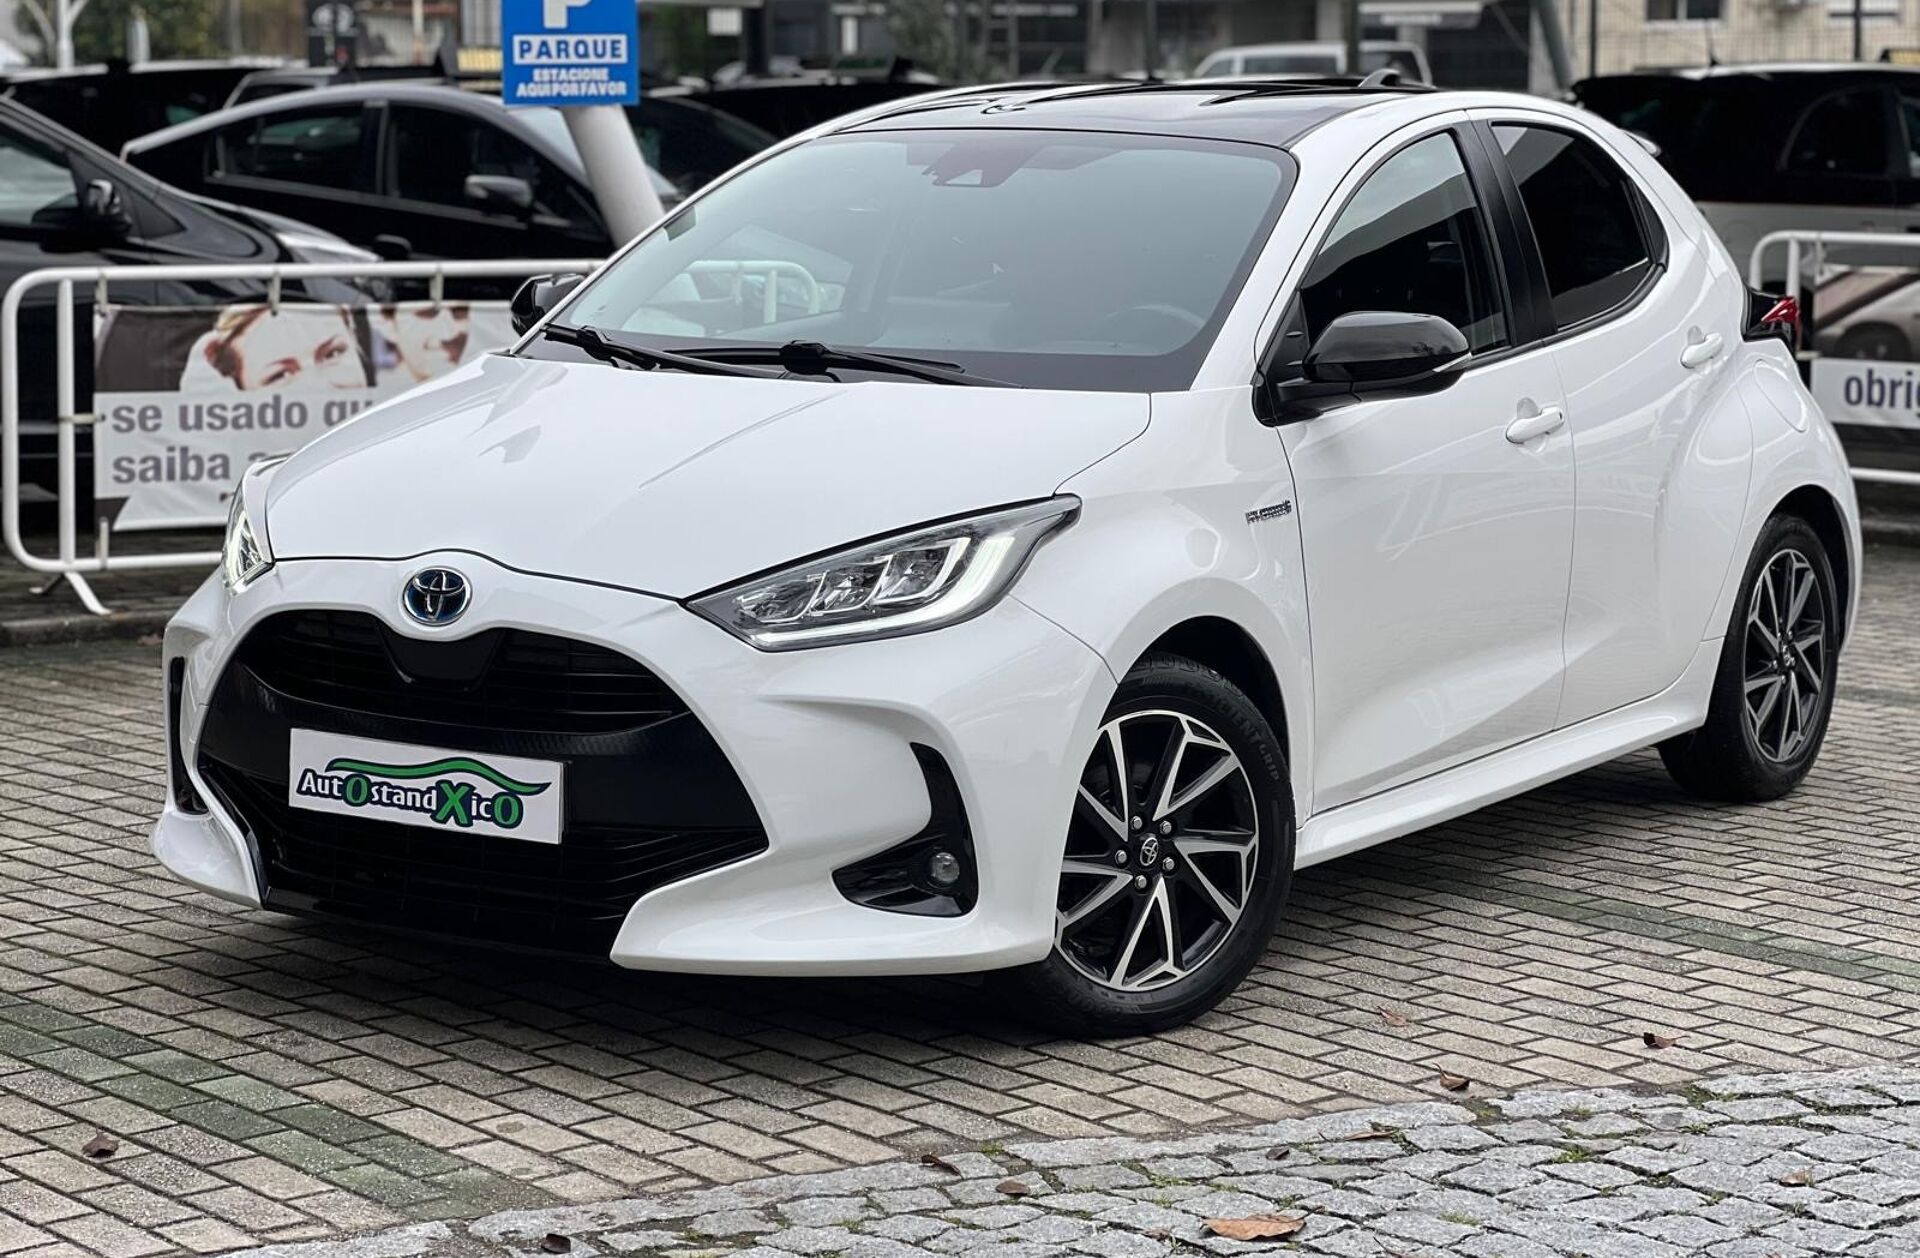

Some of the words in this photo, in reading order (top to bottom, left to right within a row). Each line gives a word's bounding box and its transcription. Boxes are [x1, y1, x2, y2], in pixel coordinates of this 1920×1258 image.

[518, 39, 623, 60] PARQUE
[532, 67, 609, 81] ESTACIONE
[111, 403, 162, 433] se
[178, 394, 308, 432] usado
[111, 446, 231, 484] saiba
